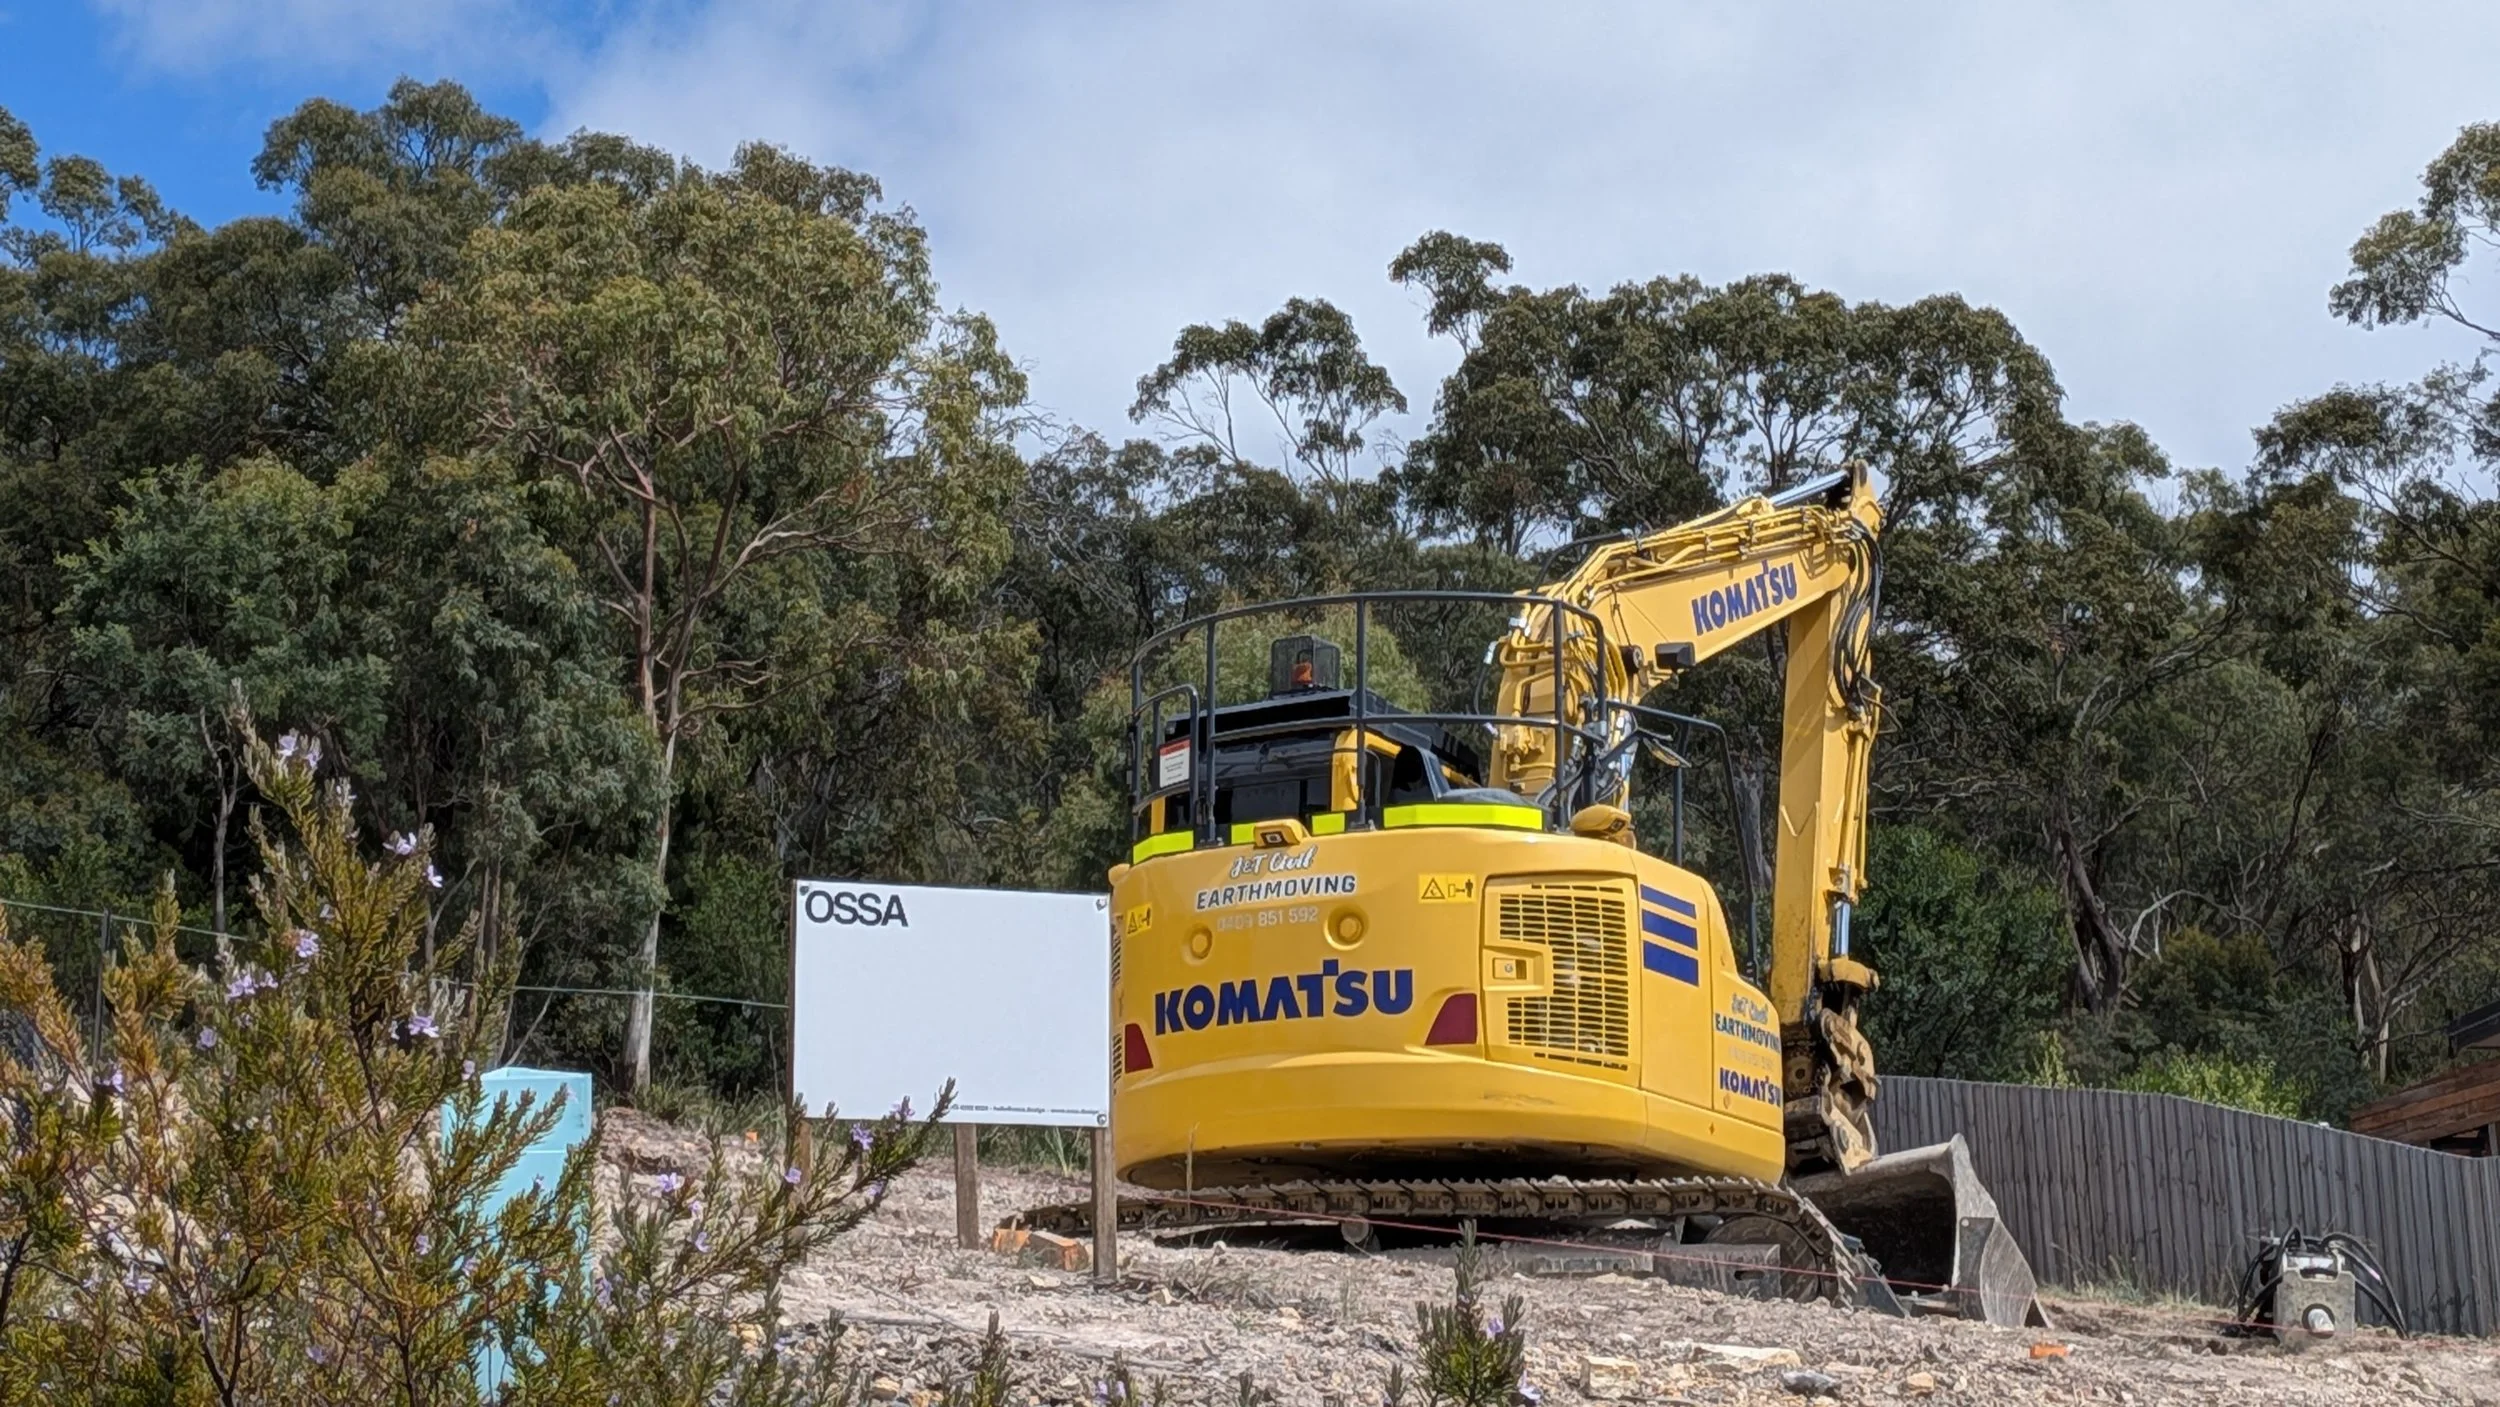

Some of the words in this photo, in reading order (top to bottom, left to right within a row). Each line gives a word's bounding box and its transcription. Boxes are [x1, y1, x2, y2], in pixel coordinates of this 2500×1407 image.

[1691, 559, 1797, 636] KOMATSU
[805, 890, 909, 927] OSSA
[1196, 875, 1356, 910] EARTHMOVING
[1258, 910, 1284, 926] 851
[1288, 907, 1318, 924] 592
[1155, 959, 1413, 1036] KOMATSU
